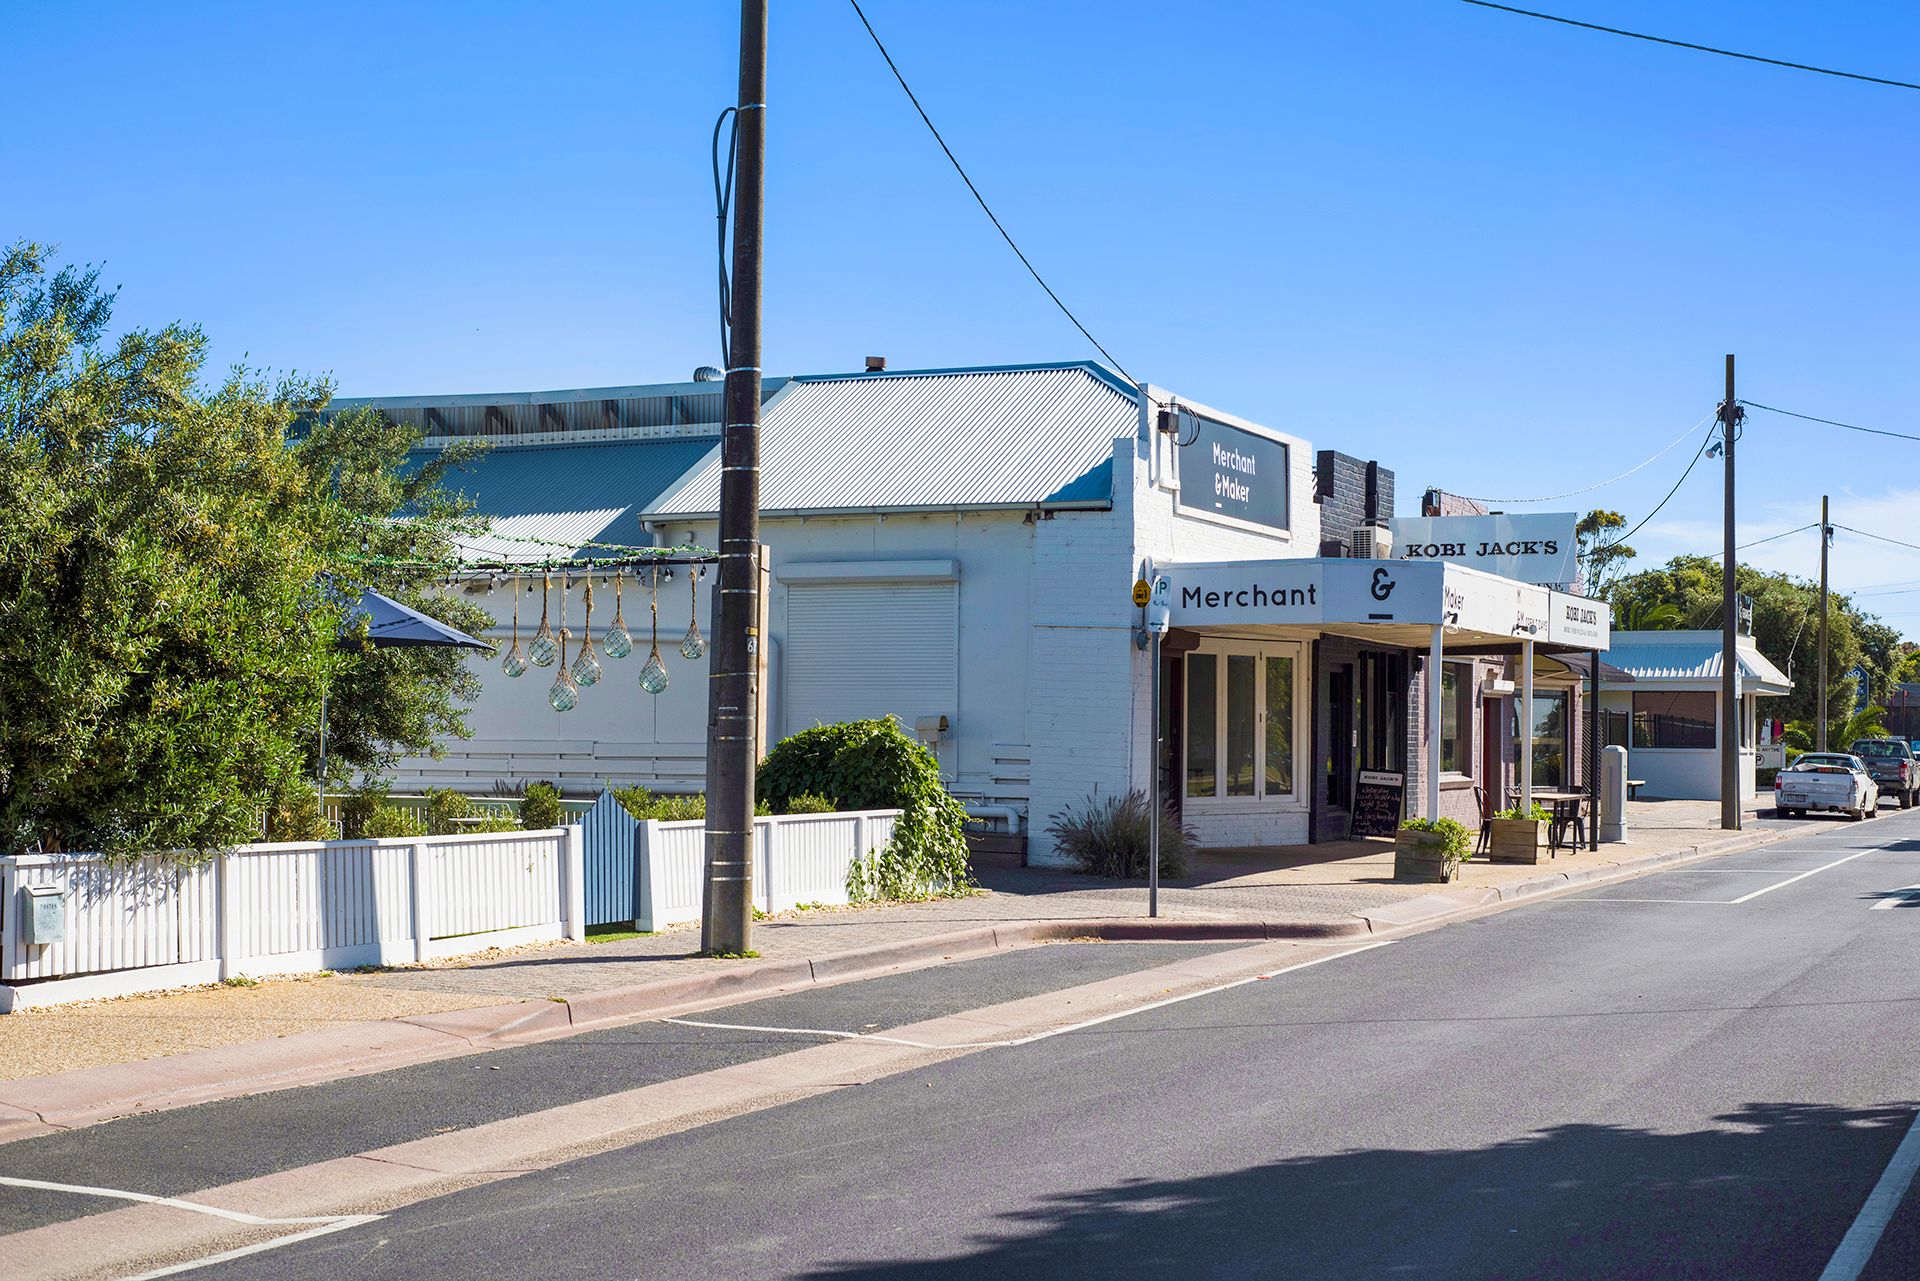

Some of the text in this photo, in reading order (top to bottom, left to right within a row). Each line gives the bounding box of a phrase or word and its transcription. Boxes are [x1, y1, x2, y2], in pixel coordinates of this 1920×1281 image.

[1213, 442, 1256, 475] Merchant
[1405, 540, 1558, 558] KOBI JACK'S
[1182, 567, 1396, 609] Merchant &
[1444, 585, 1464, 611] Maker
[1565, 605, 1579, 622] KOBI
